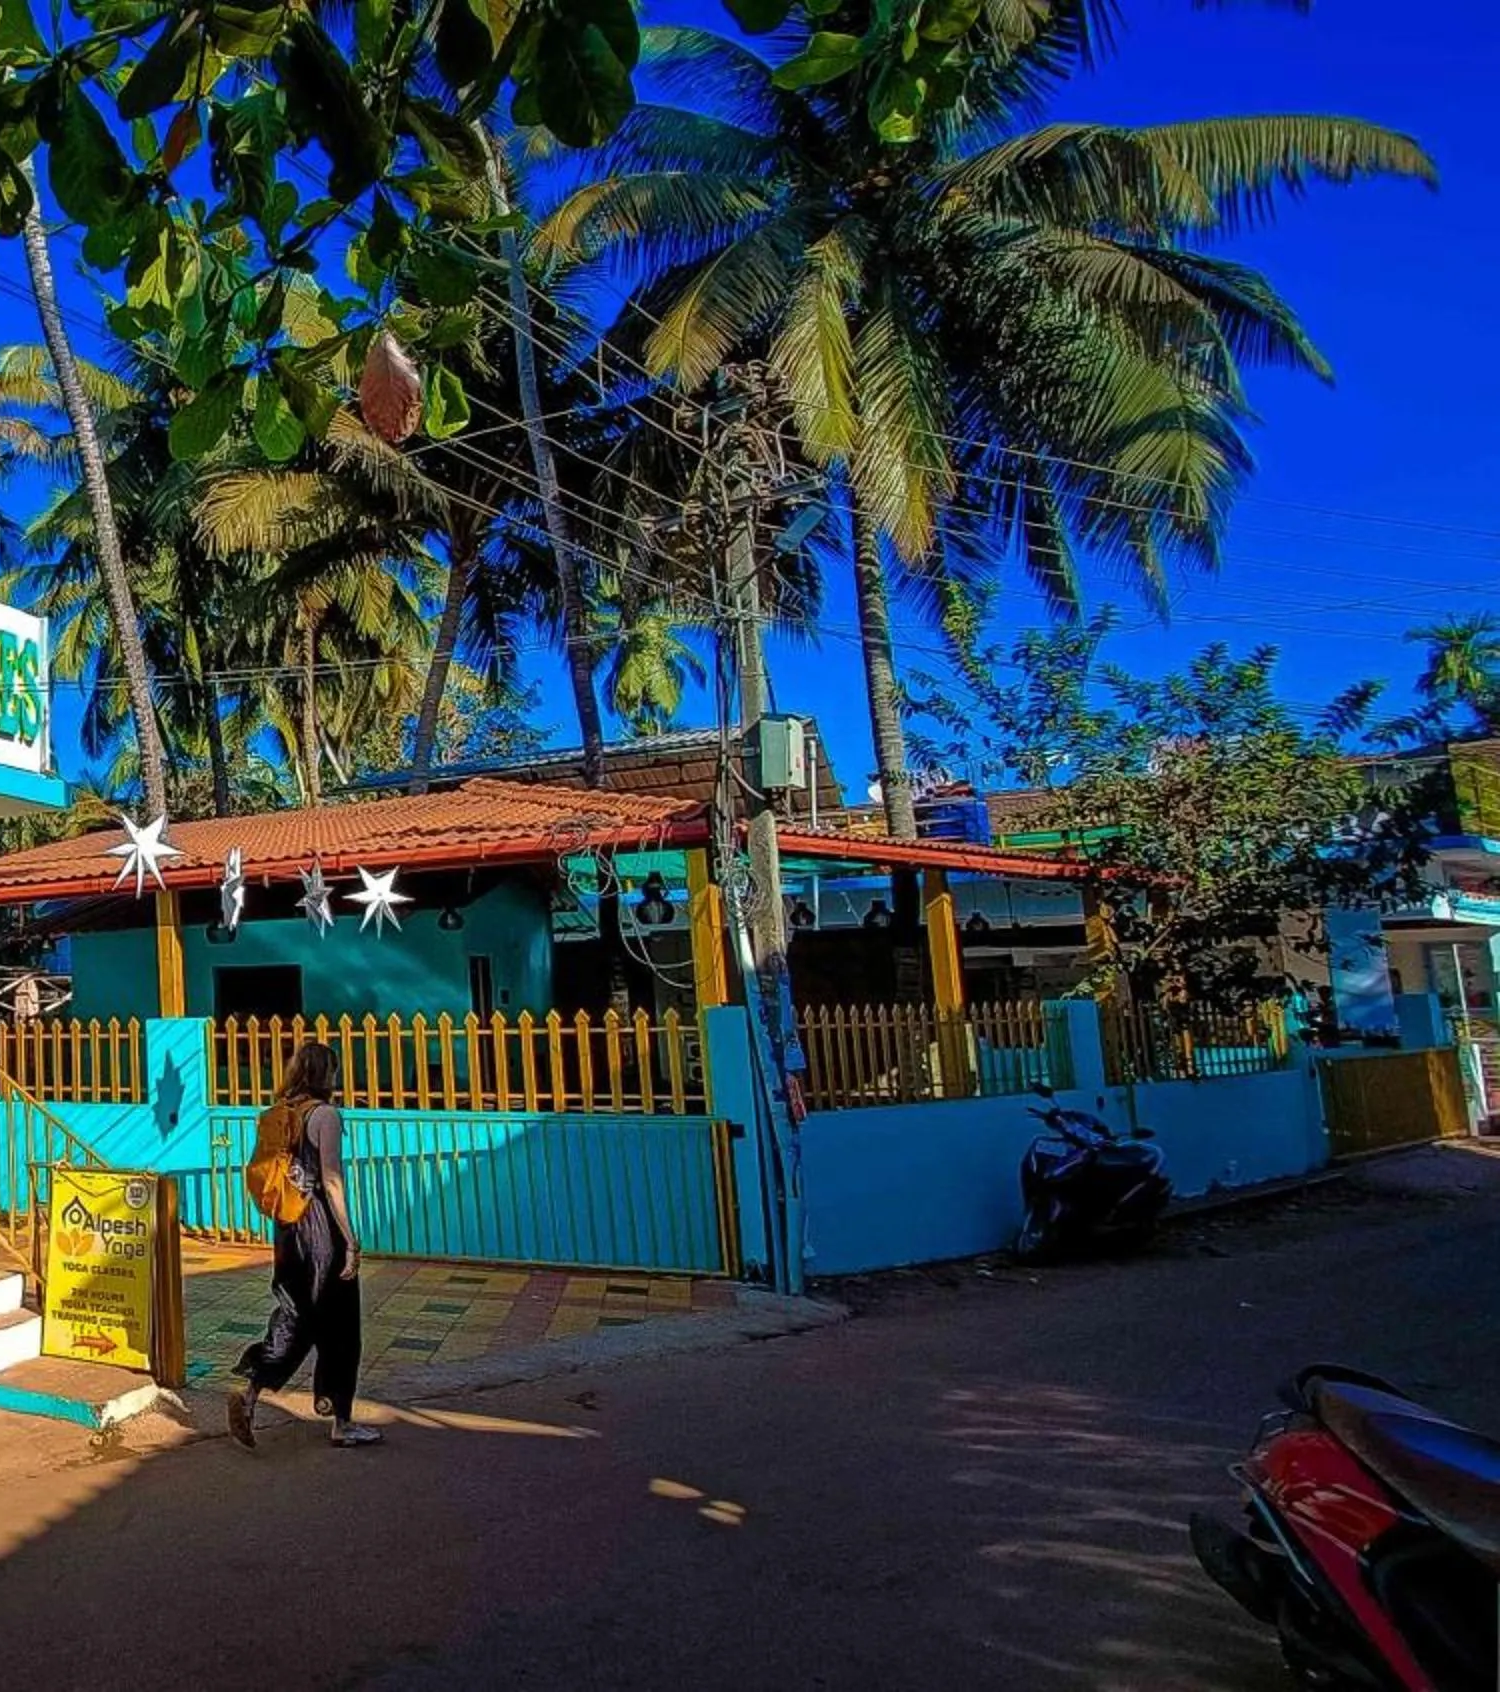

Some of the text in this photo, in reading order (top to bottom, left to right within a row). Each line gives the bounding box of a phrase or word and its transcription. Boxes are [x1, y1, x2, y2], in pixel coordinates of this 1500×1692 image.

[82, 1213, 147, 1238] Alpesh
[102, 1235, 145, 1260] Yoga
[62, 1262, 89, 1273] YOGA
